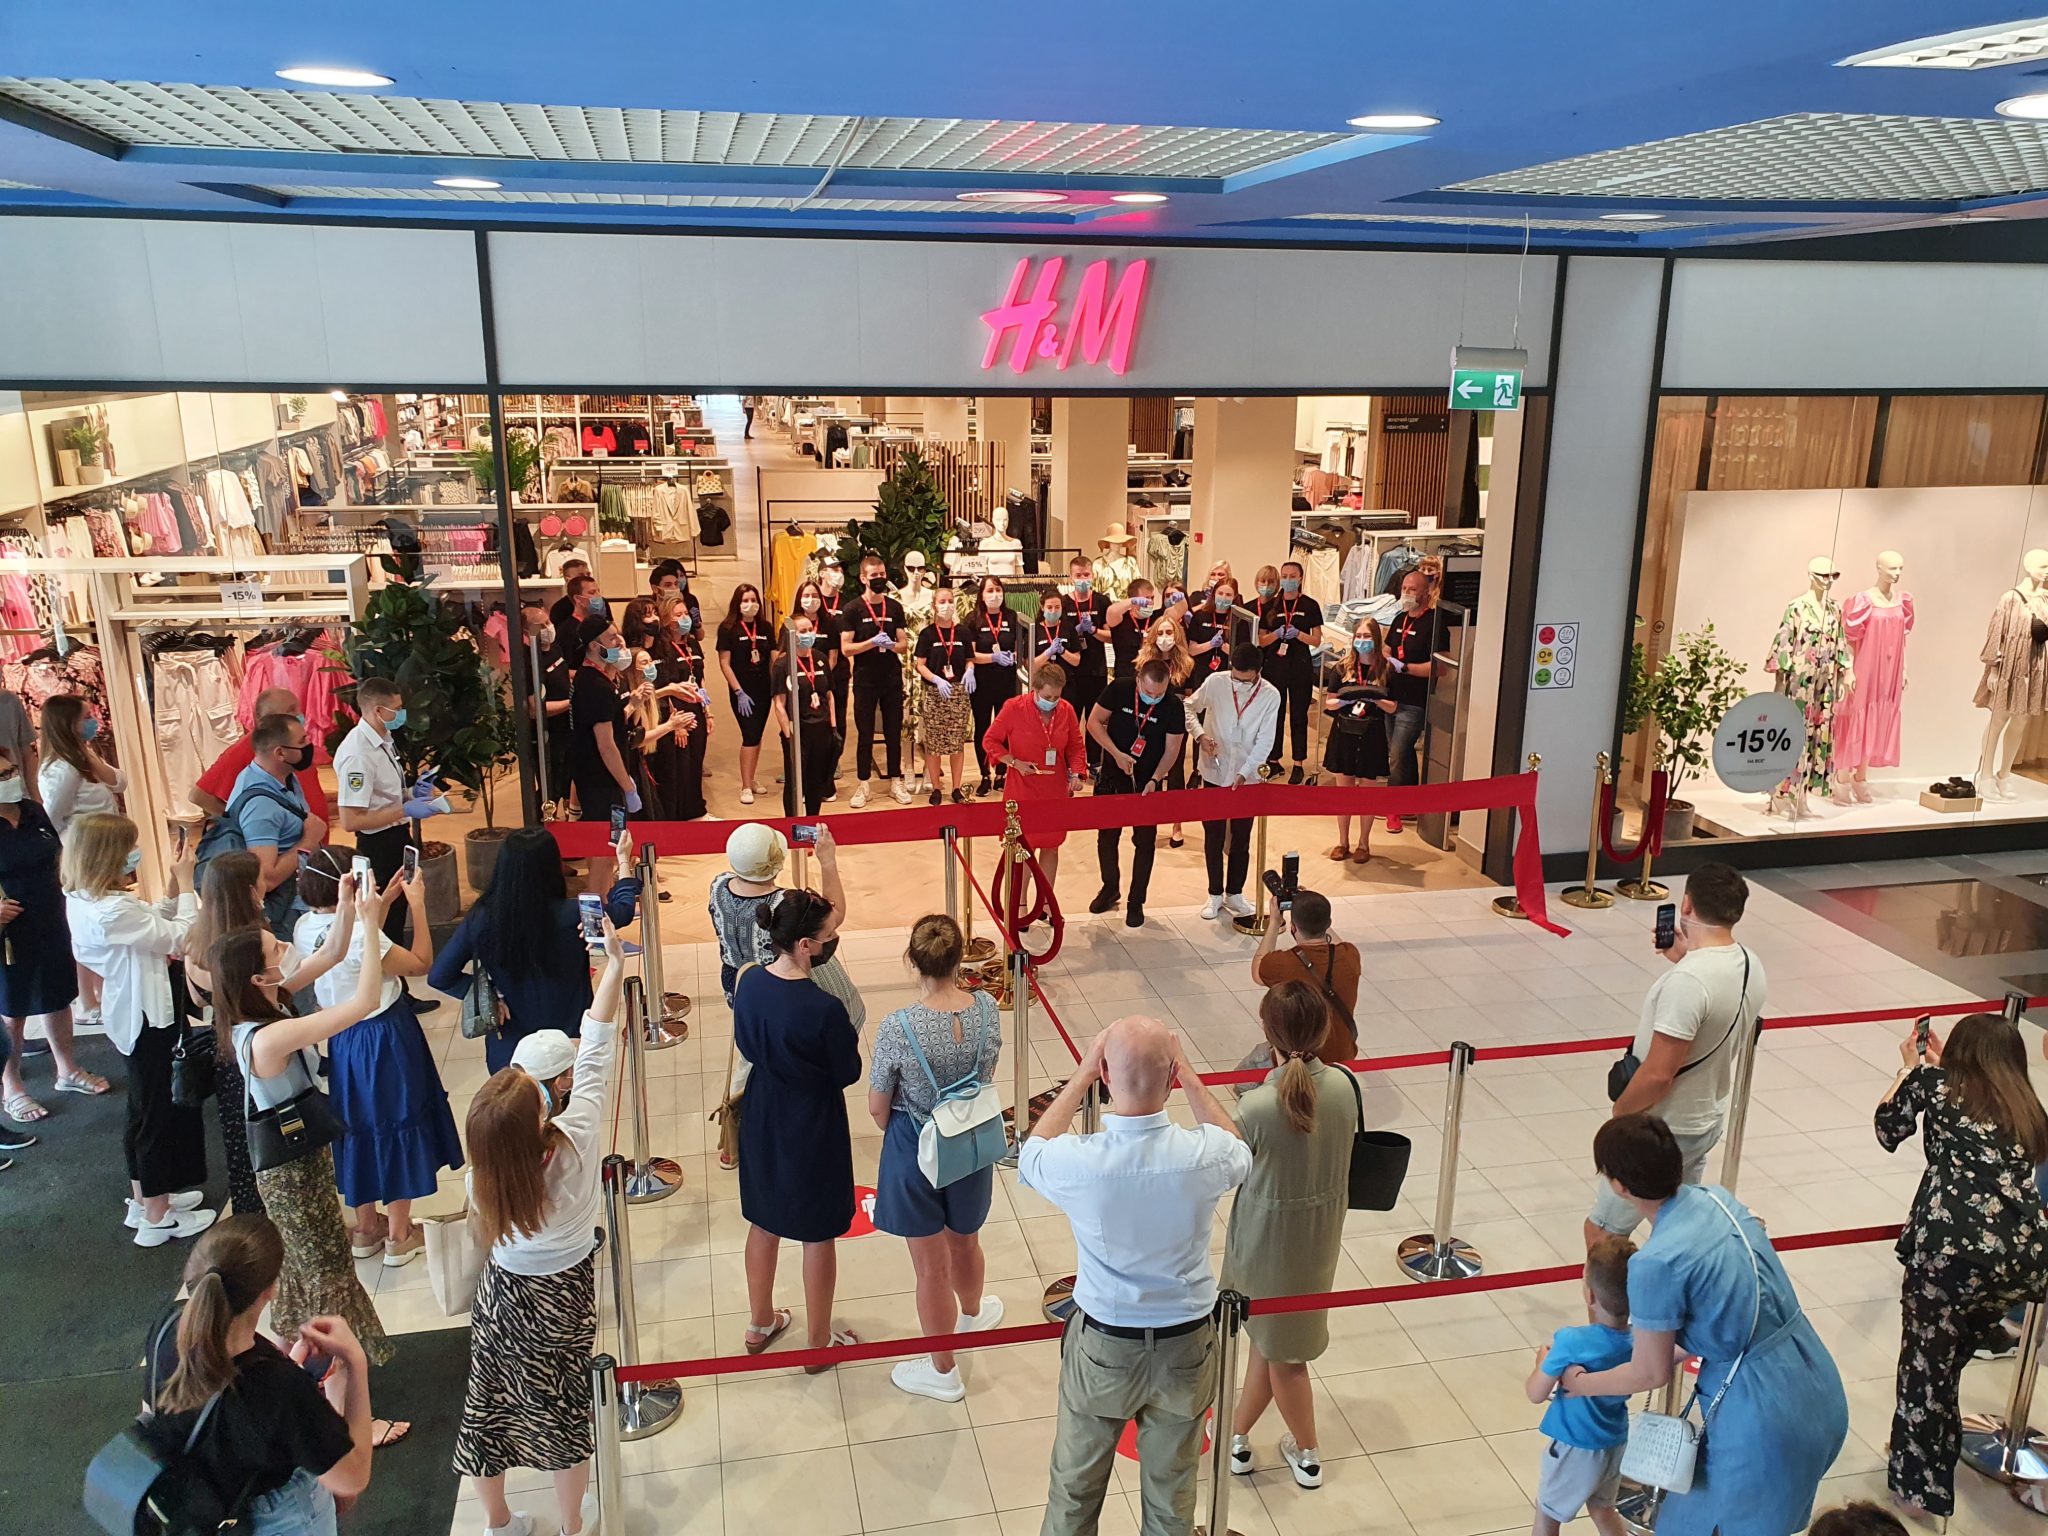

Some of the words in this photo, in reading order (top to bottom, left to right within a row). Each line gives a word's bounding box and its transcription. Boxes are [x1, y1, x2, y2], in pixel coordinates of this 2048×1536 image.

[979, 256, 1147, 375] H&M
[227, 590, 257, 600] -15%
[1726, 728, 1791, 753] -15%
